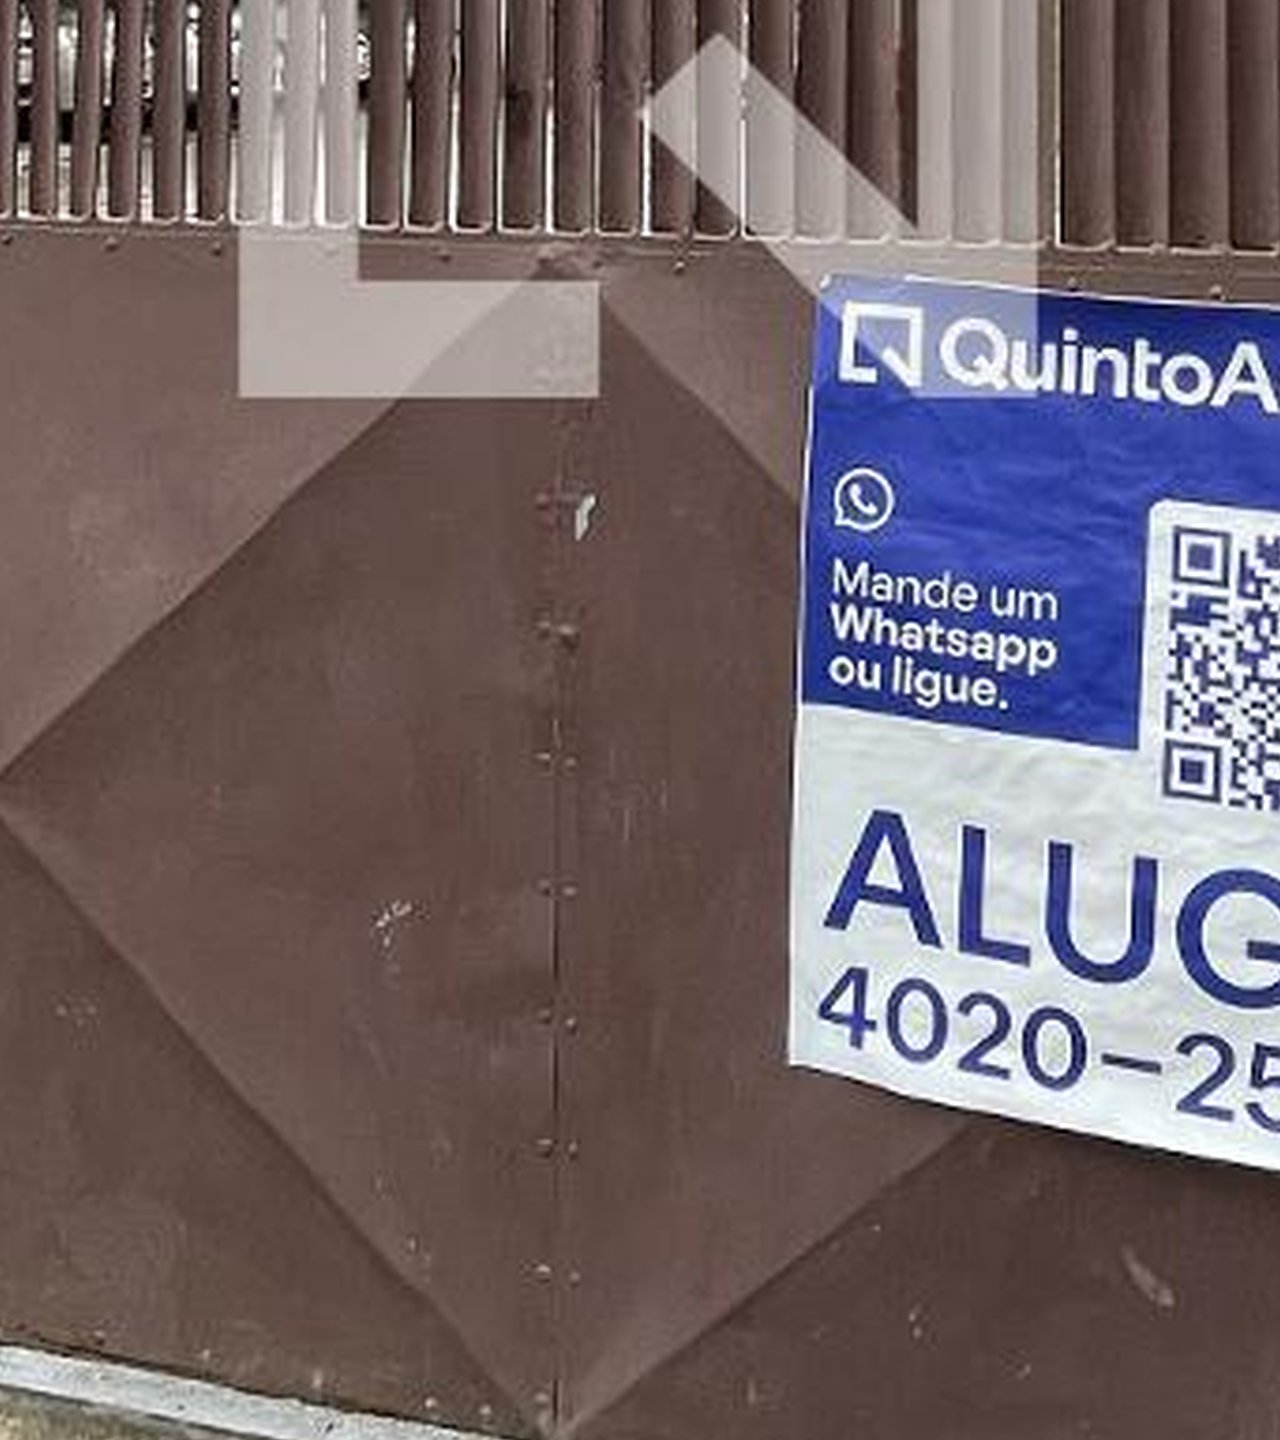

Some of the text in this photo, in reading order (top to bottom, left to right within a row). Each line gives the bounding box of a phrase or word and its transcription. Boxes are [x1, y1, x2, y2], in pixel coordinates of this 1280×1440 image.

[832, 557, 1059, 621] Mande um
[829, 601, 1058, 677] Whatsapp
[828, 654, 1010, 710] ou ligue.
